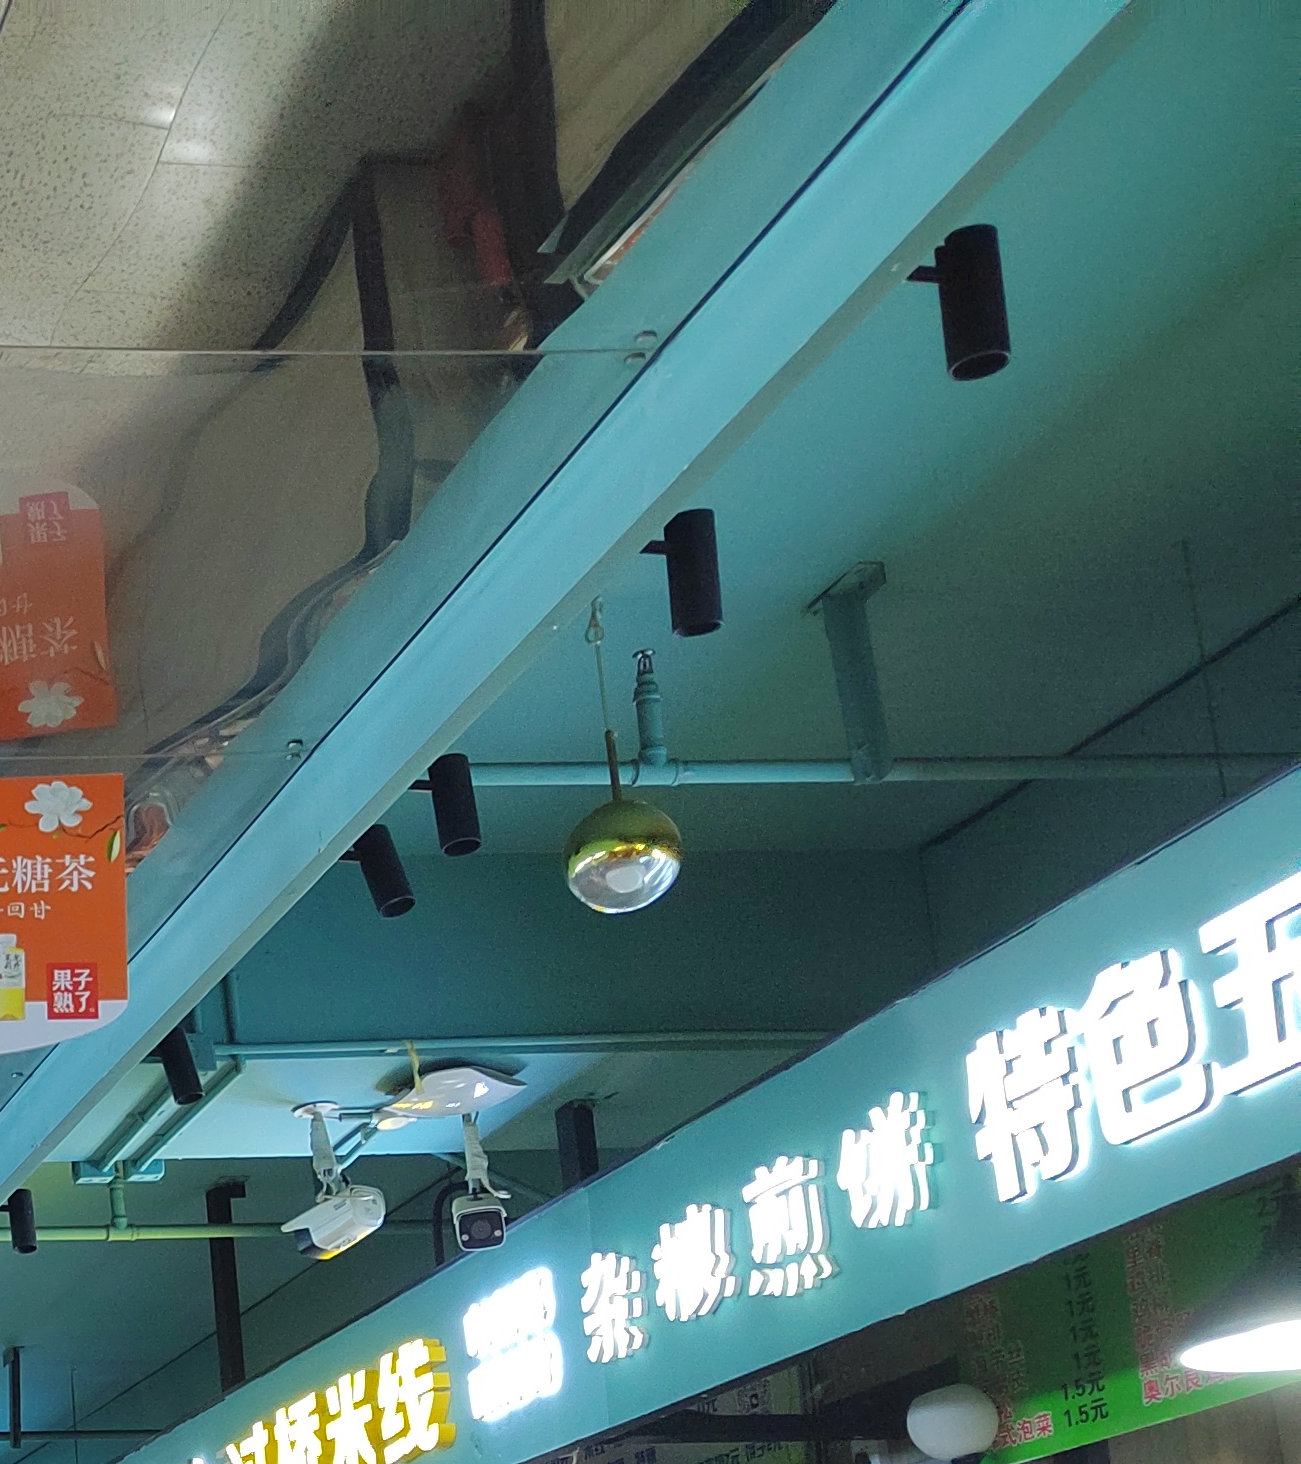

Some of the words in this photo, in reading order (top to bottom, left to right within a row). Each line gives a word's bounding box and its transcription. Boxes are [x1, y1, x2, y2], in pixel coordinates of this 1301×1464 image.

[51, 968, 93, 990] 果子
[53, 991, 91, 1013] 熟了
[1062, 1372, 1106, 1401] 1.5元
[994, 1412, 1053, 1448] 式泡菜
[1063, 1398, 1109, 1428] 1.5元
